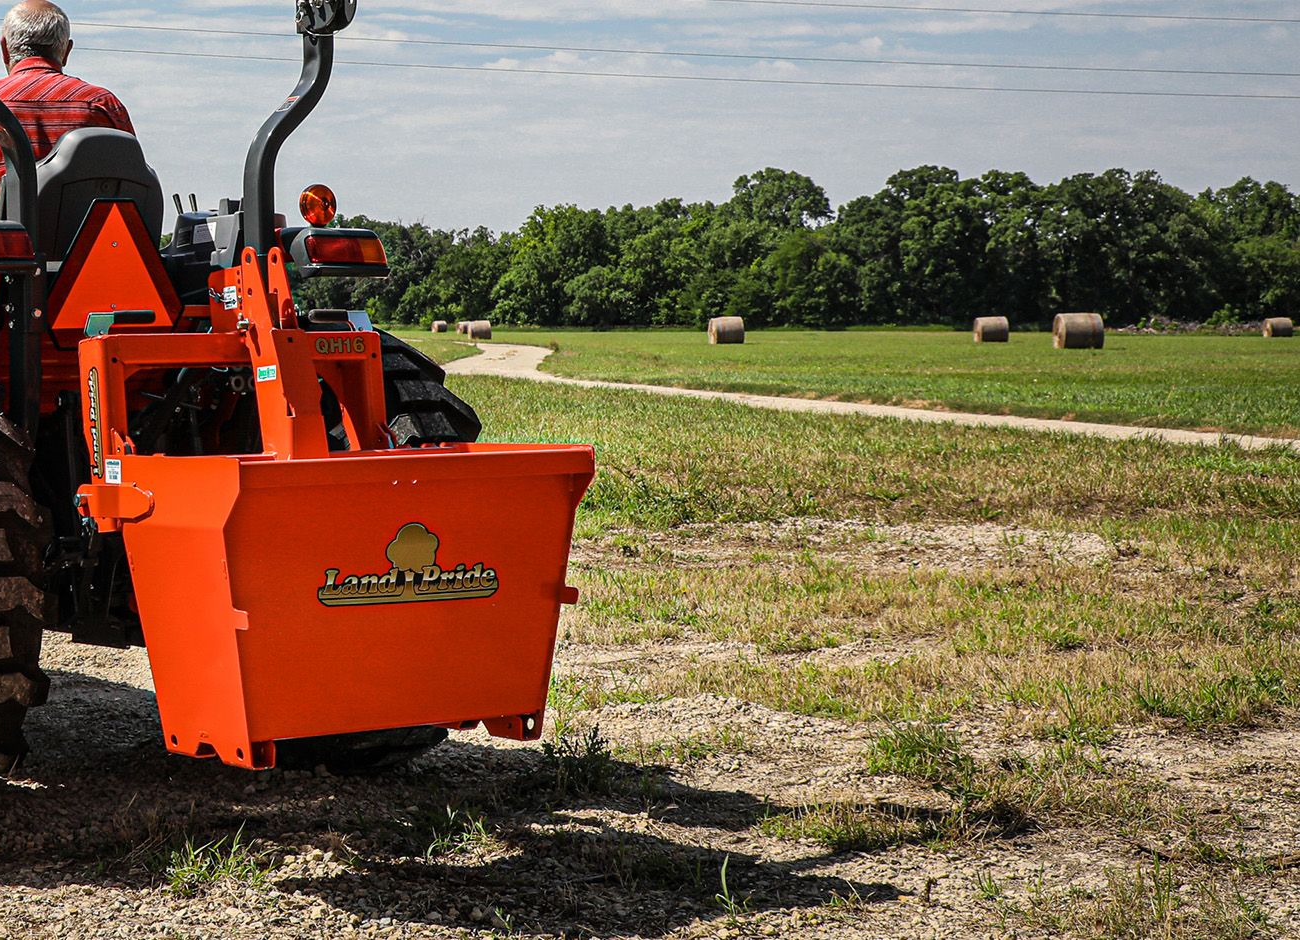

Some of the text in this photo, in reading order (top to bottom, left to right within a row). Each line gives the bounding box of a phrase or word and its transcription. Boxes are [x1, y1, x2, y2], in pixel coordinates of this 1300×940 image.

[315, 337, 365, 354] QH16
[321, 561, 497, 598] Land Pride
